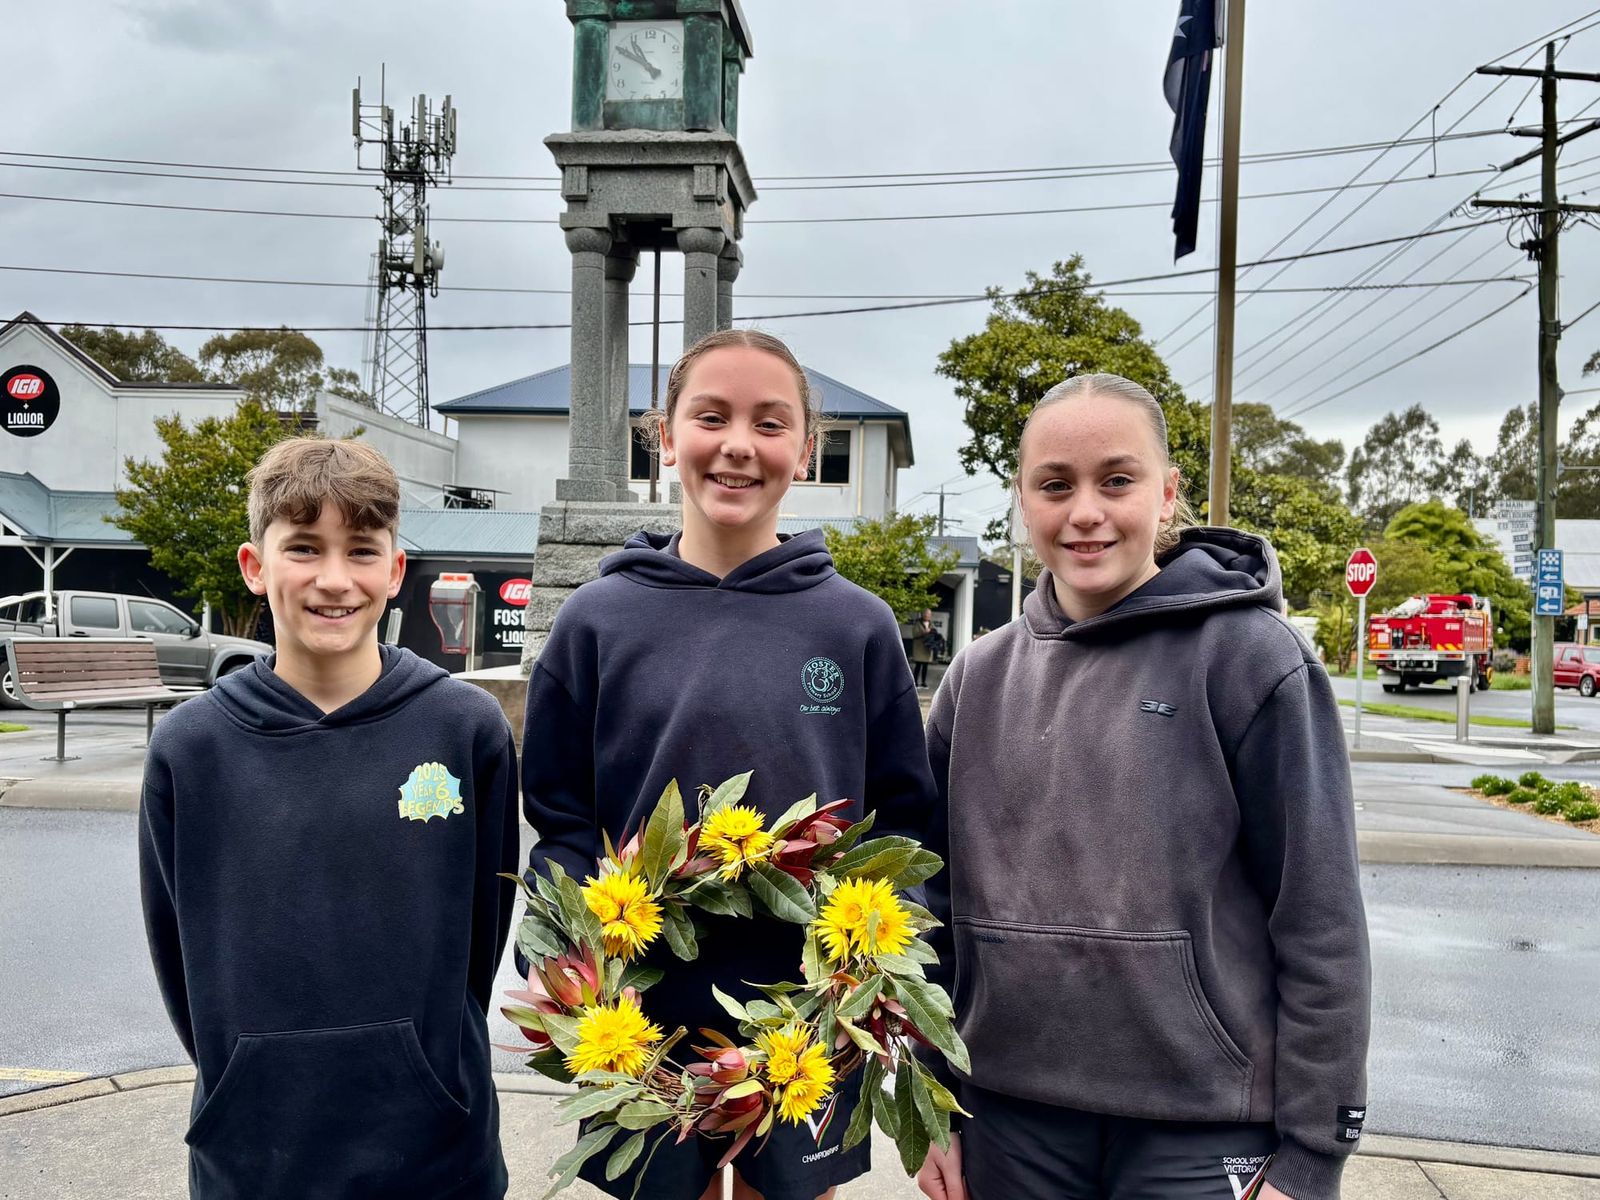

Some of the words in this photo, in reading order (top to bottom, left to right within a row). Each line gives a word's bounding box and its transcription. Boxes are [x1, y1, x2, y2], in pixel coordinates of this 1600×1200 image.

[645, 29, 657, 39] 12
[662, 34, 666, 44] 1
[671, 45, 680, 54] 2
[612, 63, 621, 72] 9
[616, 79, 625, 89] 8
[11, 379, 41, 394] IGA
[7, 412, 44, 425] LIQUOR
[1348, 563, 1375, 582] STOP
[503, 583, 532, 600] IGA
[806, 661, 839, 679] FOSTER
[414, 762, 446, 781] 2025
[436, 780, 449, 800] 6
[398, 796, 465, 819] LEGENDS
[1222, 1156, 1248, 1165] SCHOOL
[1223, 1164, 1257, 1173] VICTORIA
